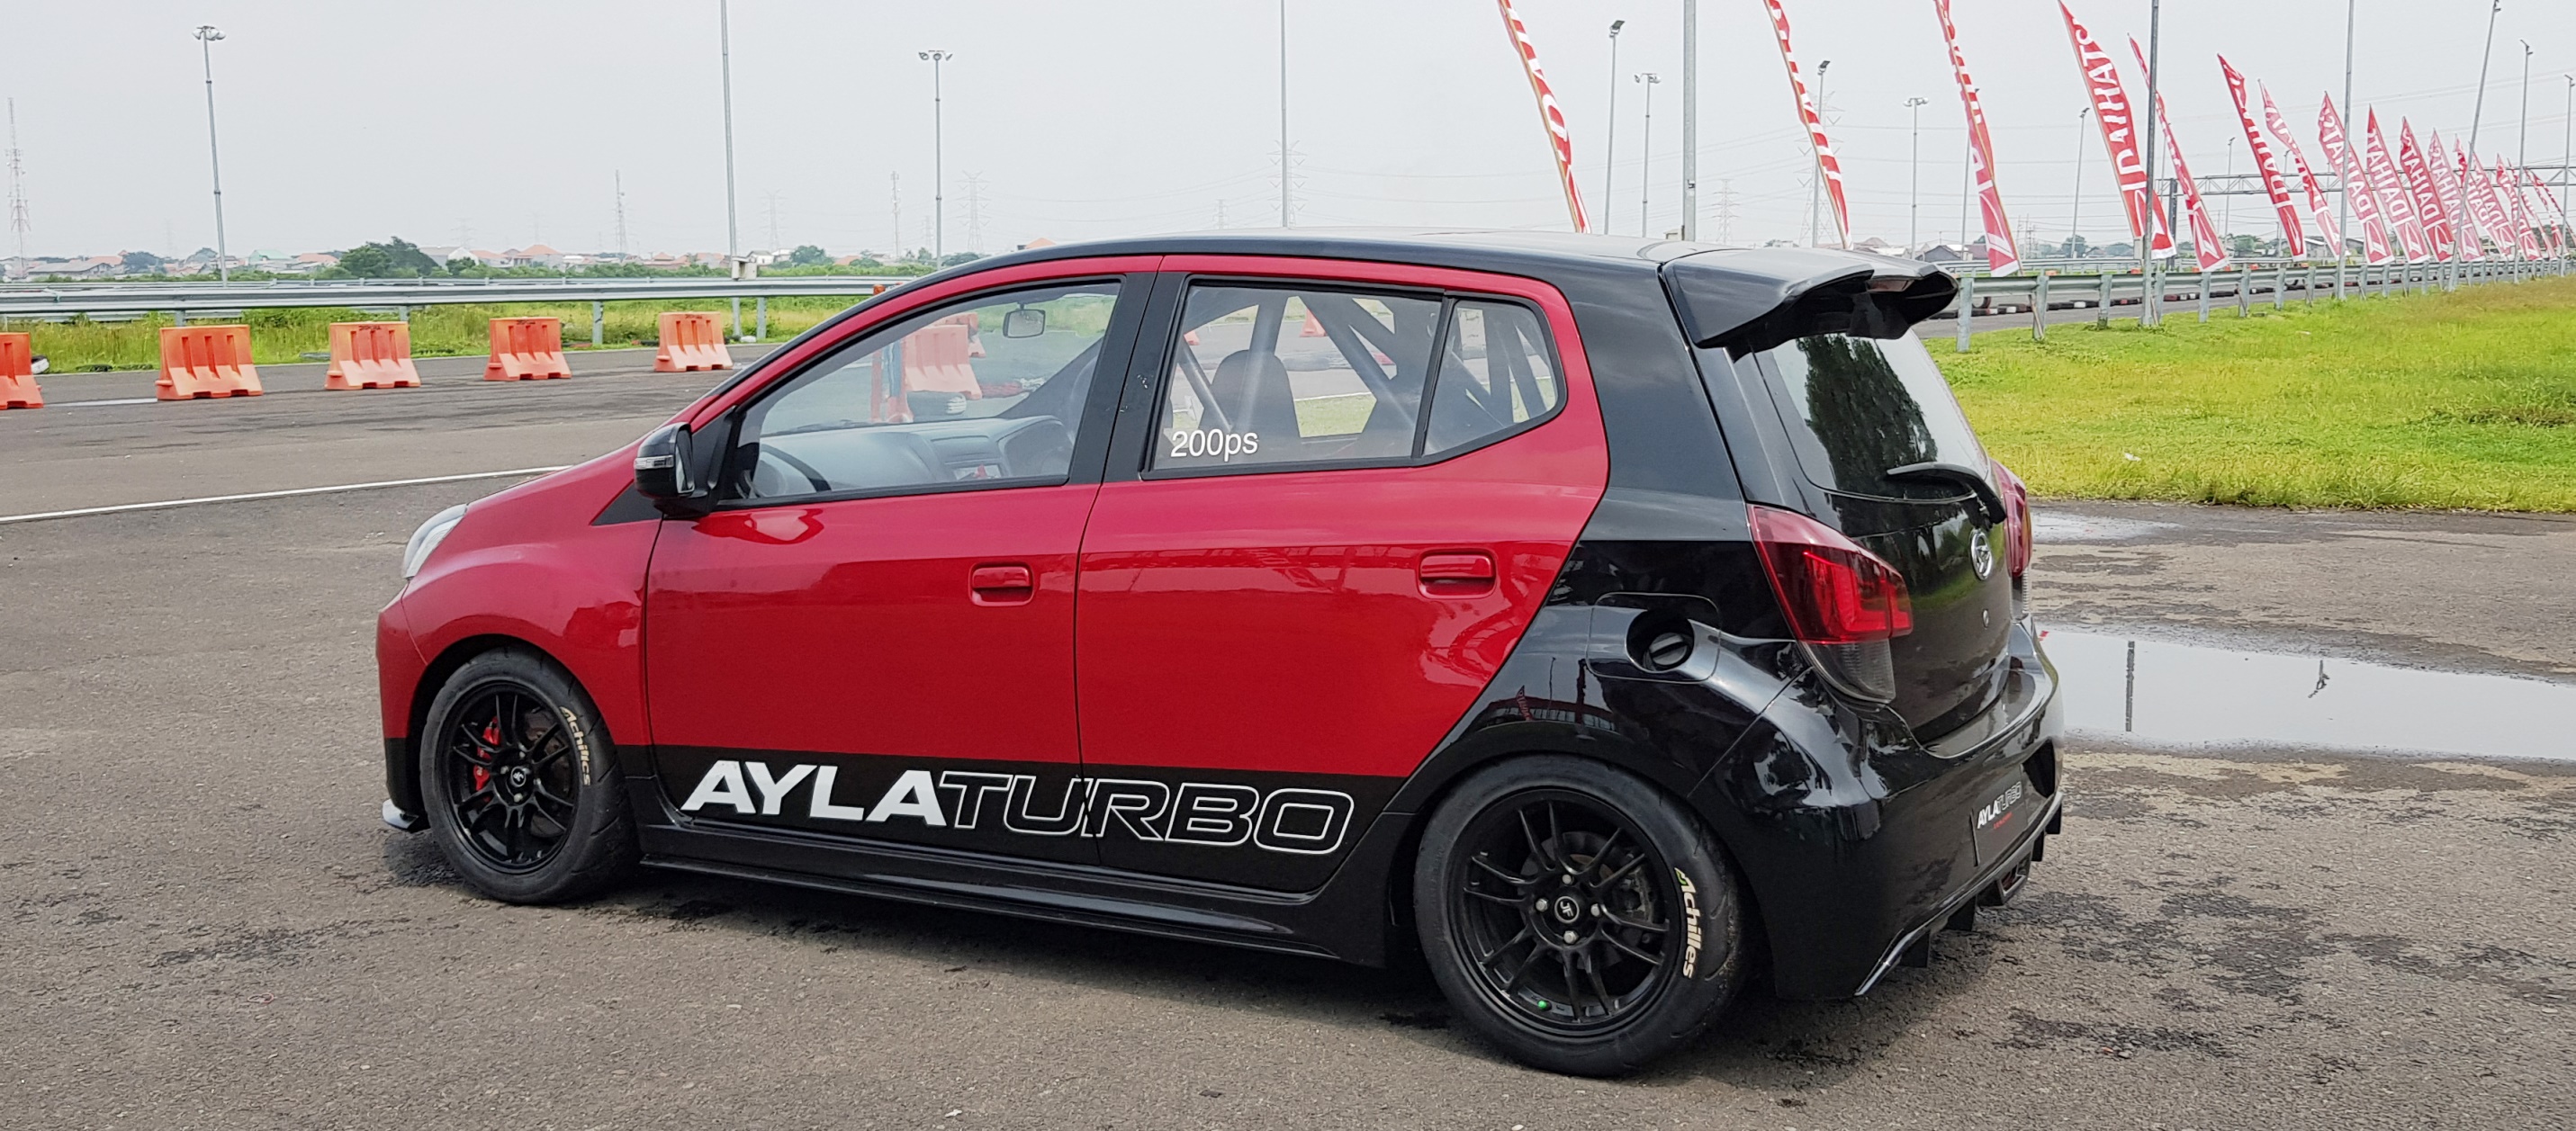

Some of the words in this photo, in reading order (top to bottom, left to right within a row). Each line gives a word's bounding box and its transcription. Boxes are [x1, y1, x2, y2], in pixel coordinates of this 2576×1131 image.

[1171, 429, 1258, 462] 200ps
[560, 706, 590, 785] Achilles
[1674, 867, 1702, 978] Achilles
